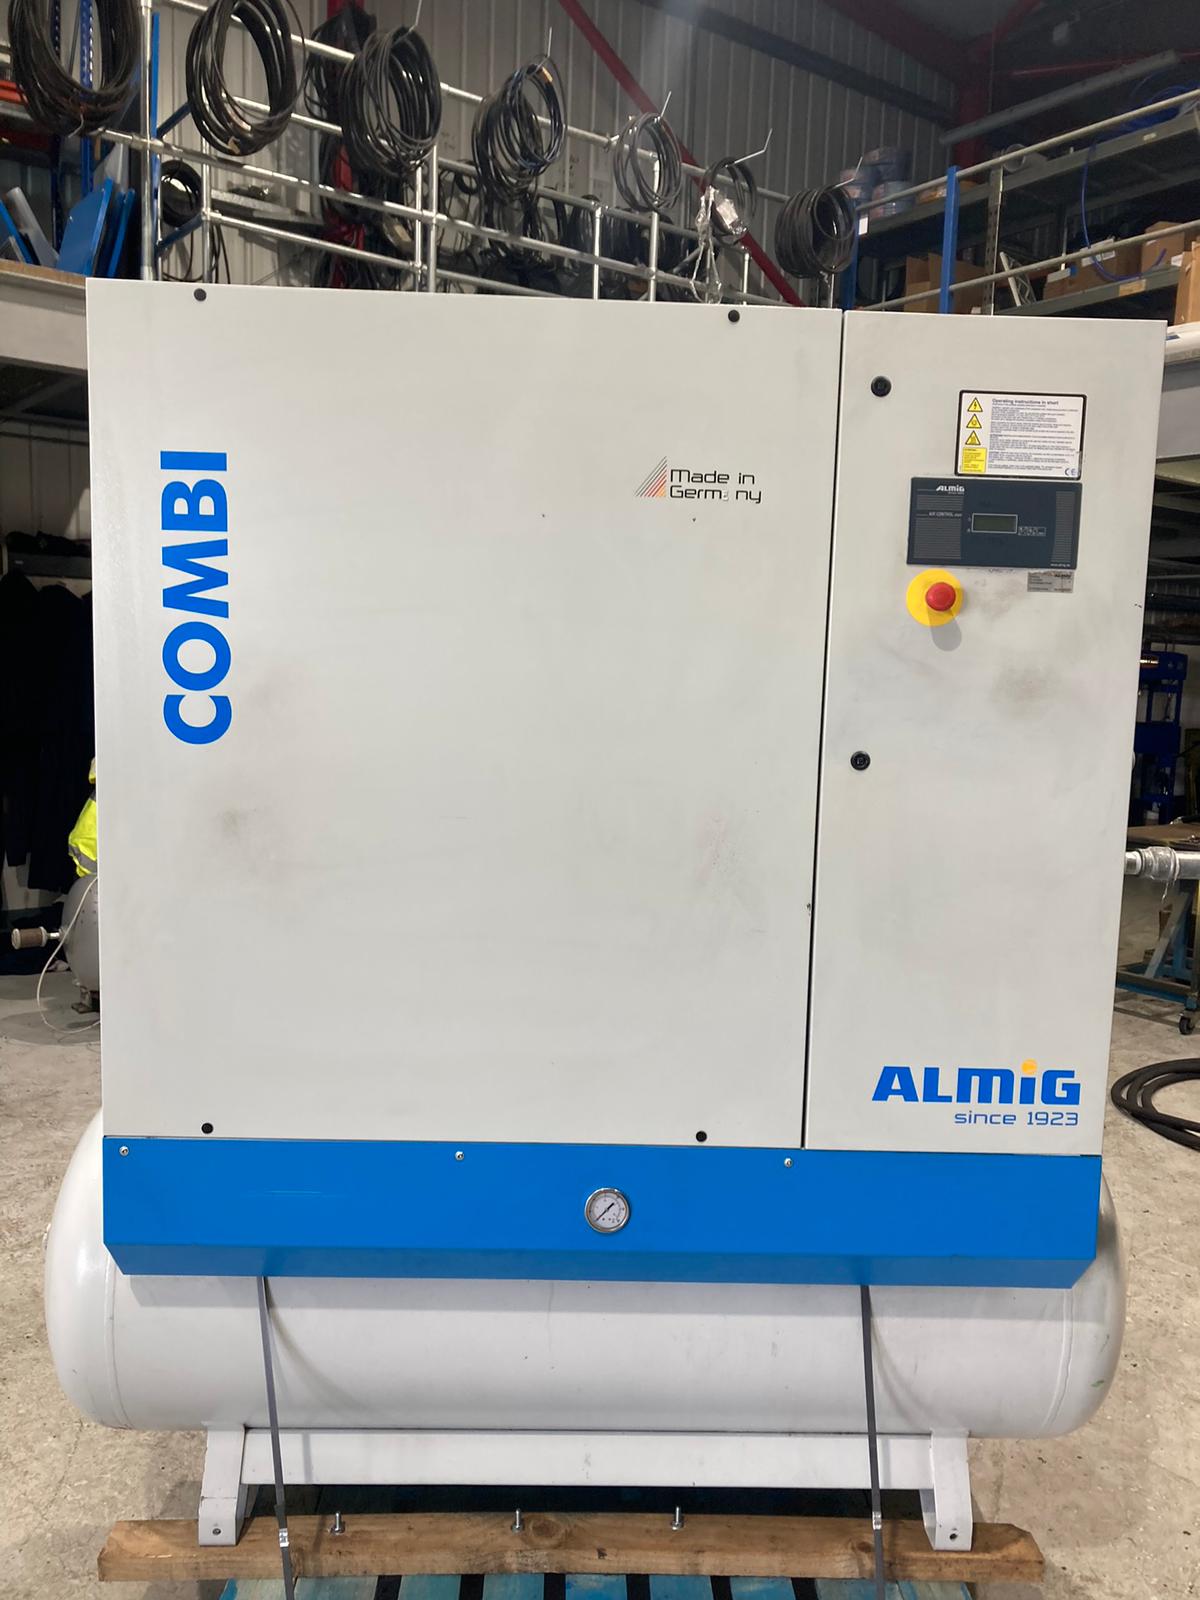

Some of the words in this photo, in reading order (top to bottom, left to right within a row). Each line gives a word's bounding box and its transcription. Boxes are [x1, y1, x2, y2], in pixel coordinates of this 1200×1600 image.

[670, 469, 730, 484] Made
[738, 472, 755, 485] in
[160, 450, 232, 745] COMBI
[954, 1110, 1016, 1125] since
[1027, 1111, 1079, 1126] 1923
